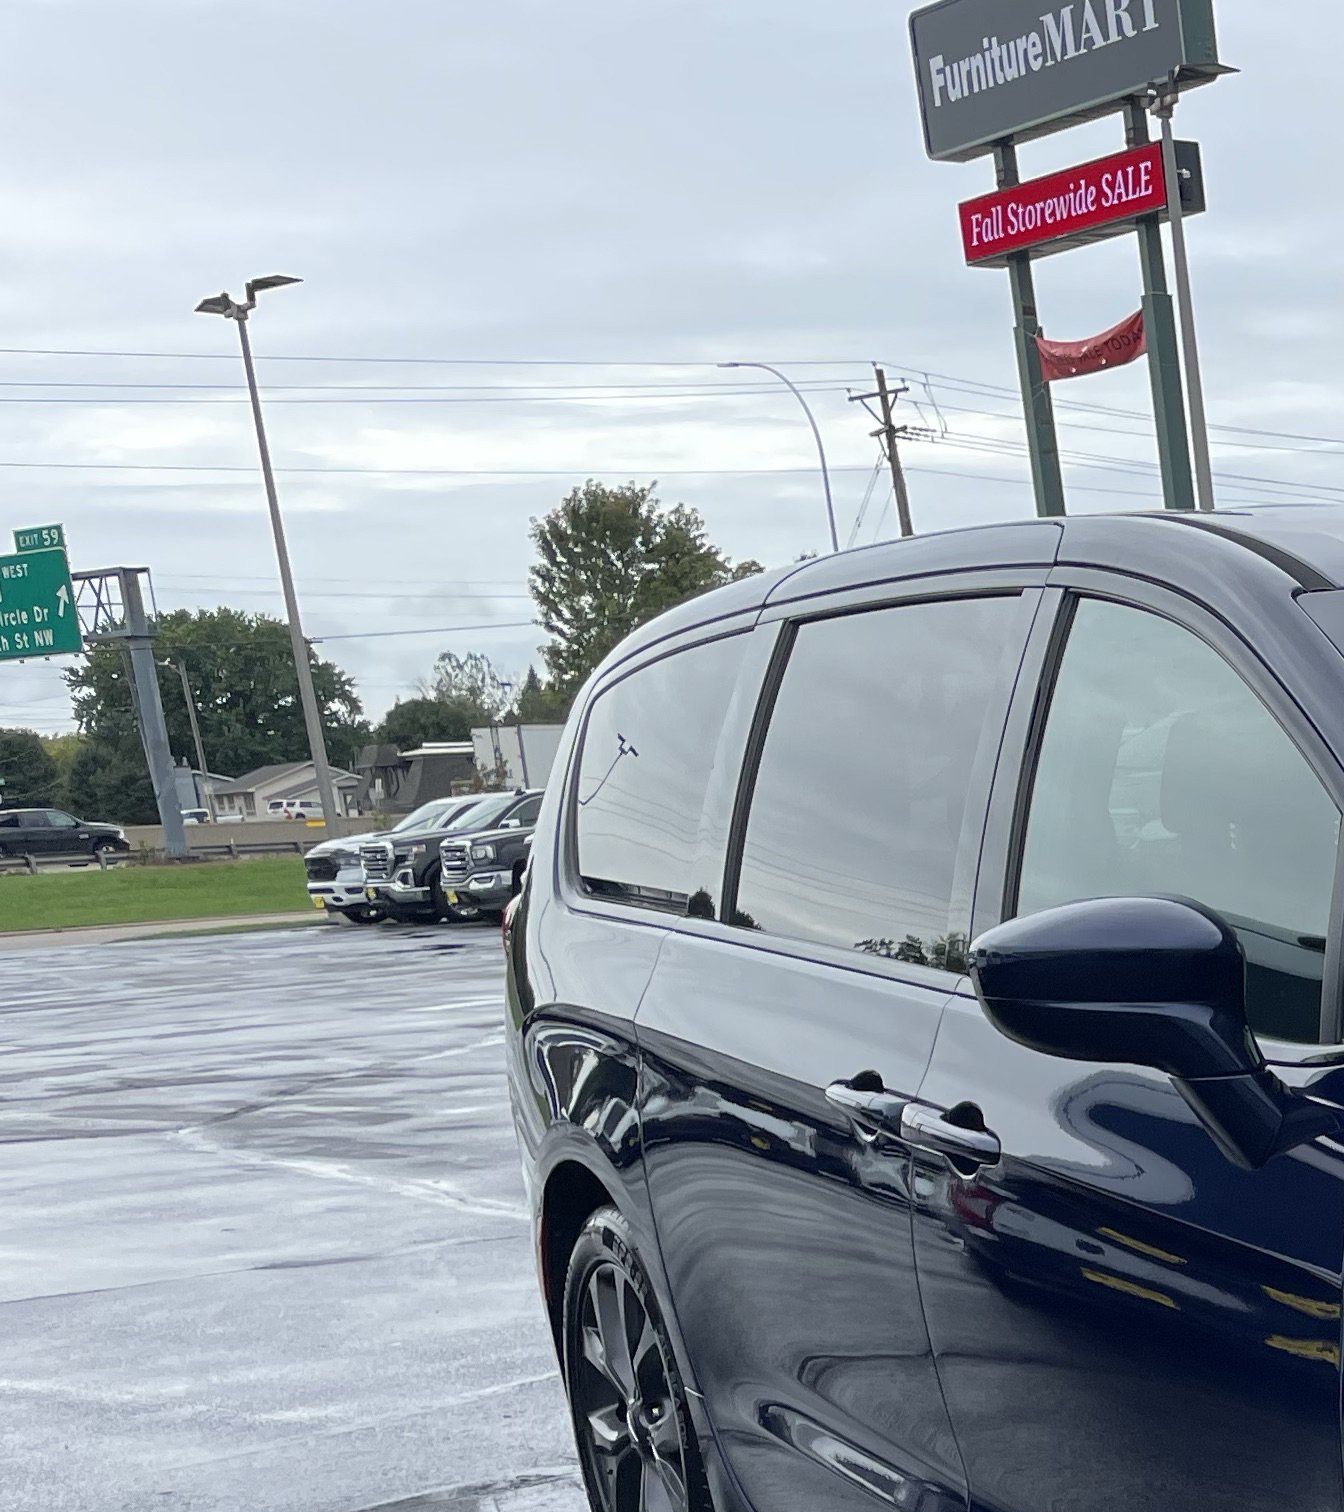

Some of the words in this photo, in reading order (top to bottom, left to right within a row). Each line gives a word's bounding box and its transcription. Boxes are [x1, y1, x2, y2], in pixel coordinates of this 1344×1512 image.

[929, 0, 1160, 107] FurnitureMART
[970, 208, 1005, 247] Fall
[1007, 181, 1097, 236] Storewide
[1101, 160, 1153, 207] SALE
[19, 533, 39, 548] EXIT
[41, 529, 59, 546] 59
[1, 564, 28, 579] WEST
[33, 605, 49, 623] Dr
[14, 632, 30, 650] St
[33, 629, 54, 648] NW
